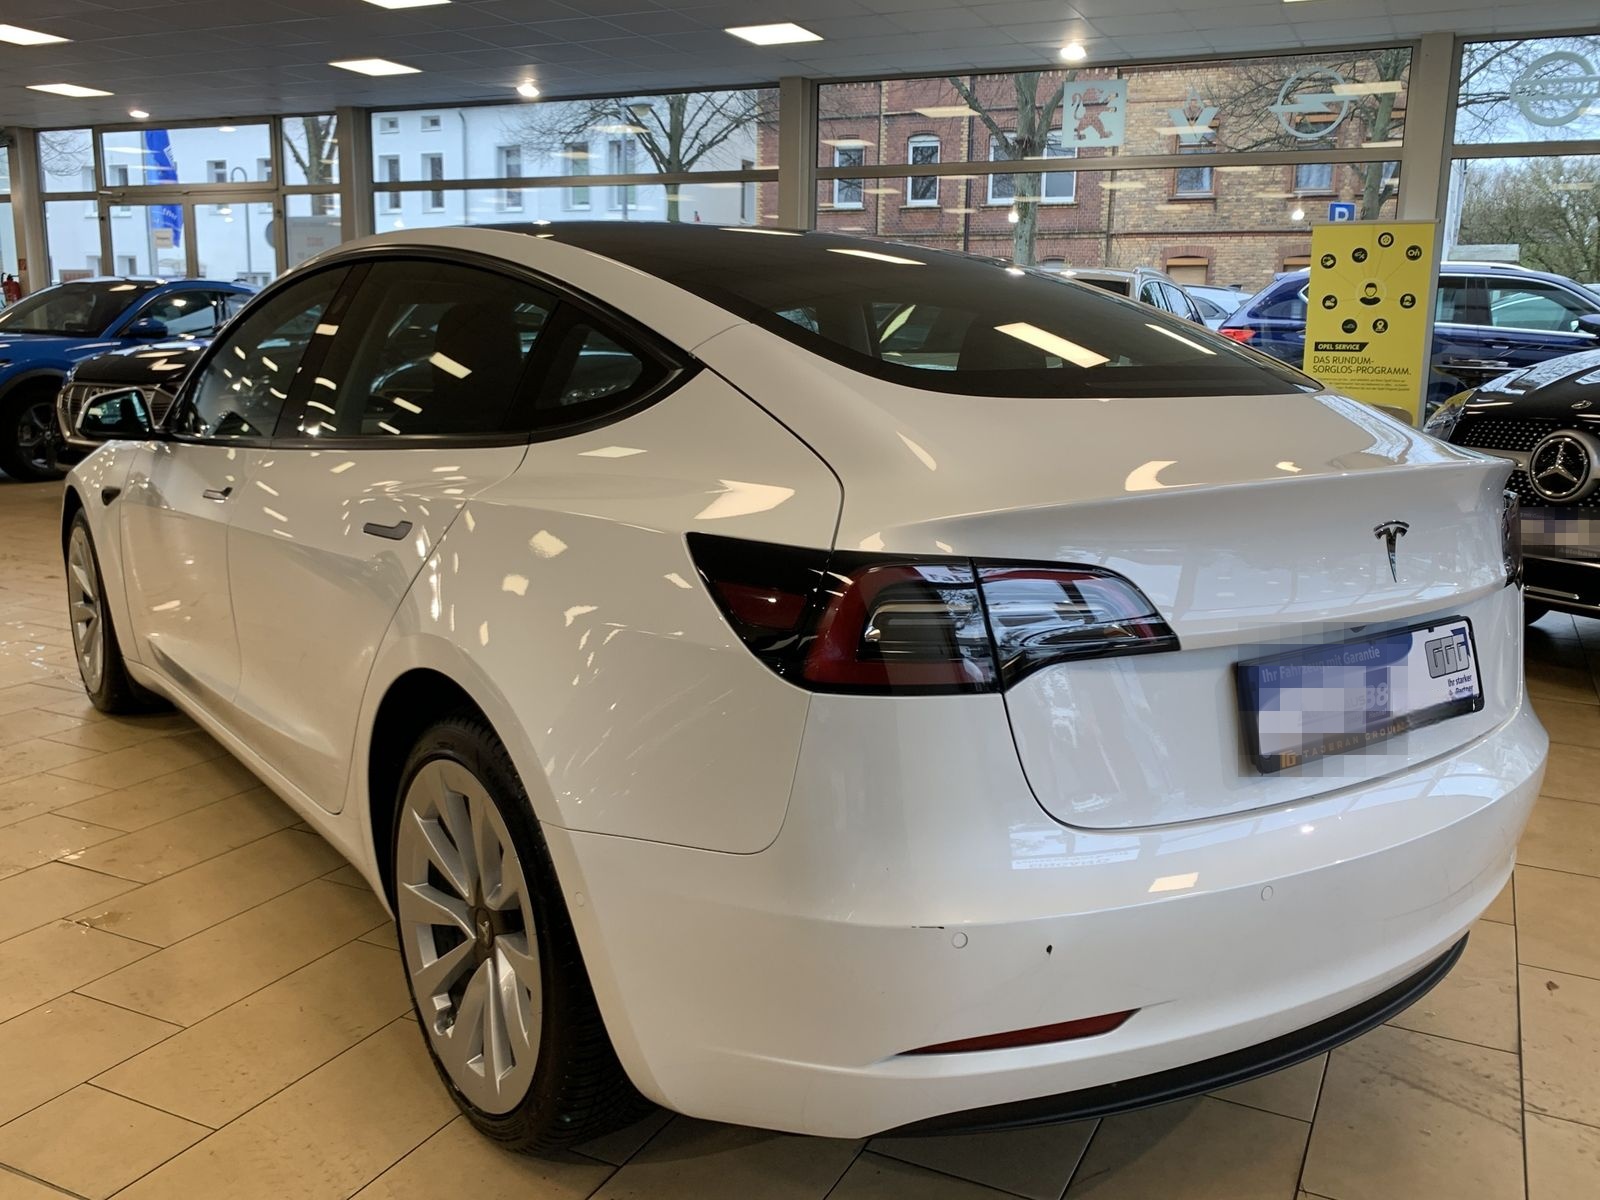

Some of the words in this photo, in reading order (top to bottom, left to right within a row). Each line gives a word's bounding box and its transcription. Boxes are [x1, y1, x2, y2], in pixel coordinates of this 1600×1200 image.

[1335, 207, 1349, 221] P
[1313, 355, 1331, 364] DAS
[1332, 356, 1375, 365] RUNDUM-
[1312, 365, 1412, 375] SORGLOS-PROGRAMM.
[1261, 668, 1278, 683] Ihr
[1326, 654, 1342, 669] mit
[1343, 646, 1381, 665] Garantie
